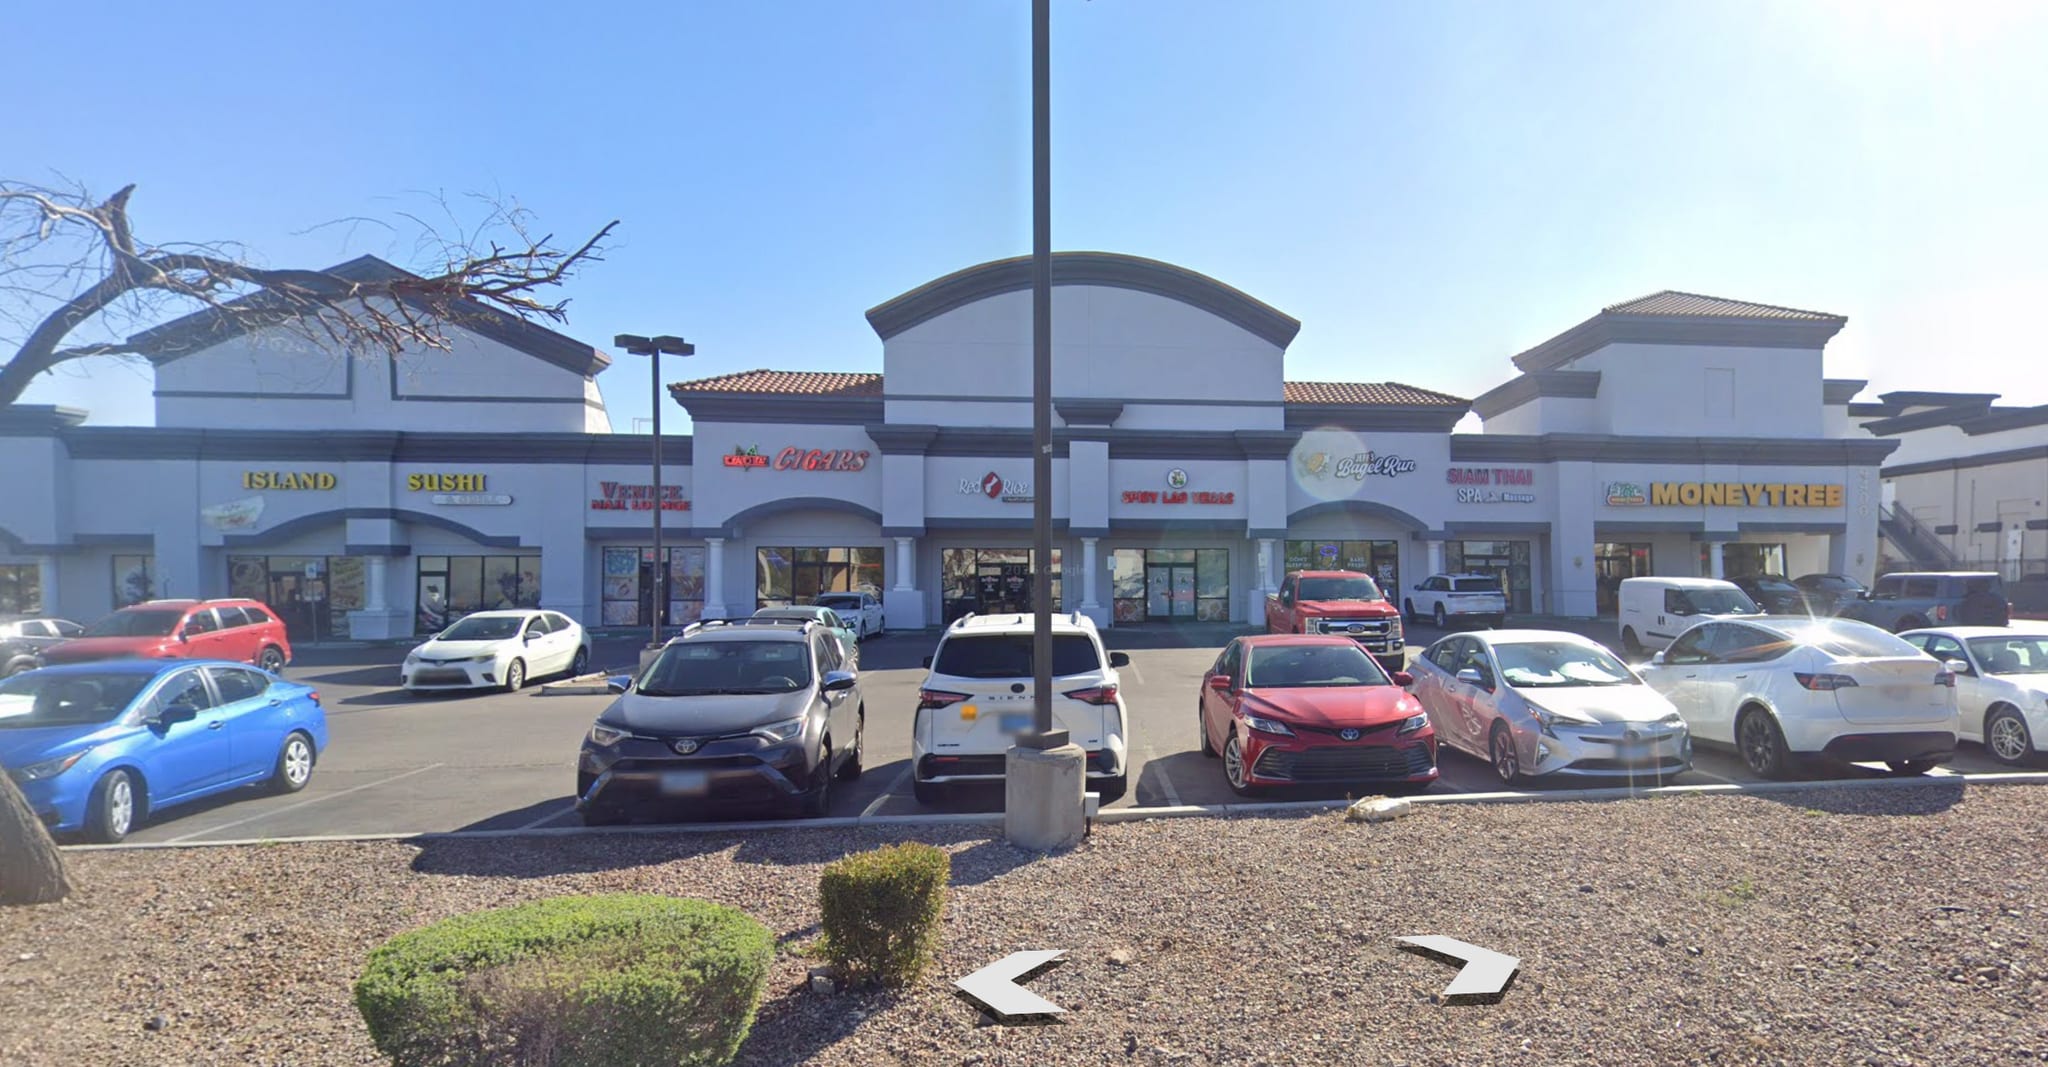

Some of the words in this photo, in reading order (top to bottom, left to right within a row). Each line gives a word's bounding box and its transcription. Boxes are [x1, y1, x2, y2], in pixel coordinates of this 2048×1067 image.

[773, 446, 870, 471] CIGARS
[1335, 456, 1383, 481] Bagel
[1383, 455, 1416, 478] Run
[243, 471, 337, 490] ISLAND
[407, 474, 487, 492] SUSHI
[959, 476, 982, 495] Red
[1493, 468, 1533, 485] THAI
[1457, 488, 1482, 503] SPA
[1650, 482, 1845, 507] MONEYTREE
